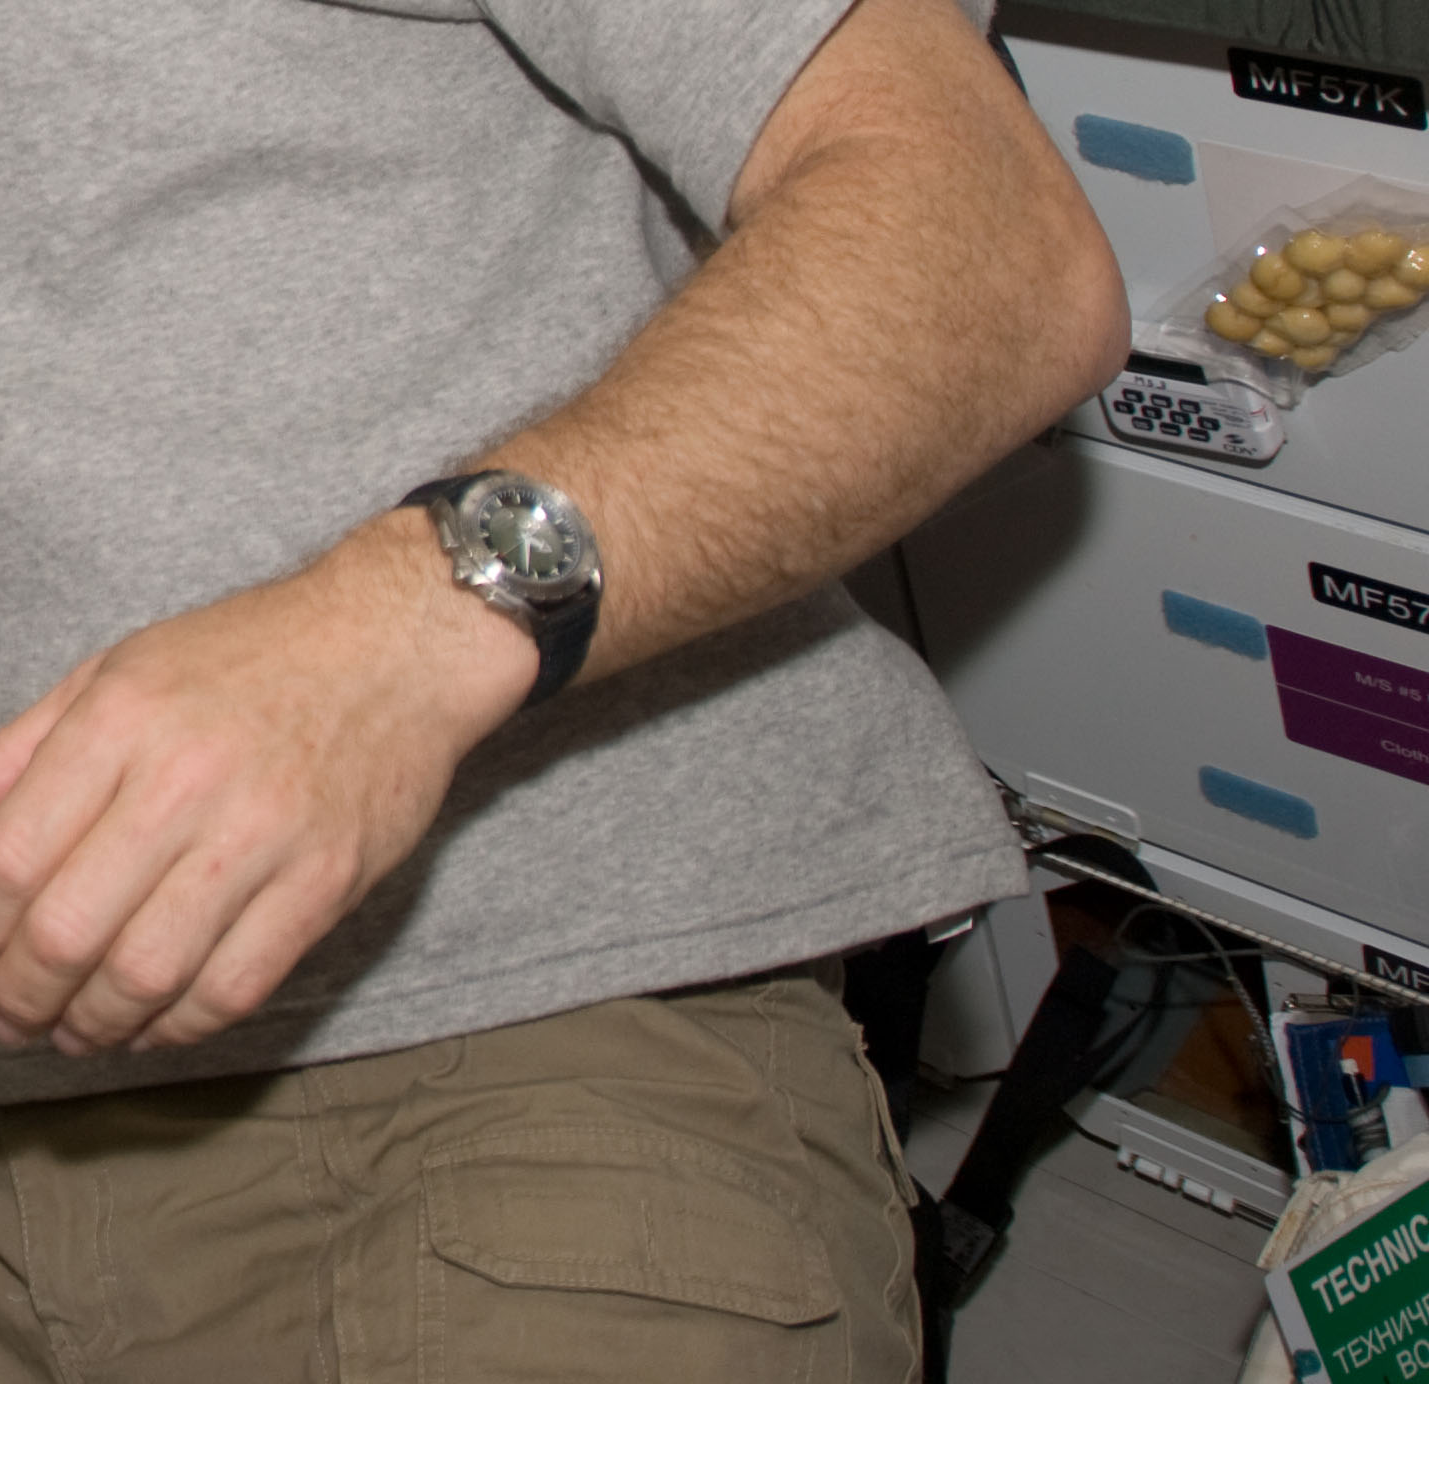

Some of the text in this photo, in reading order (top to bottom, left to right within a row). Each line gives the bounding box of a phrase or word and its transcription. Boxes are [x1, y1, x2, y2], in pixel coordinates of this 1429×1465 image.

[1248, 60, 1408, 117] MF57K
[1355, 671, 1422, 702] M/S #5
[1311, 1214, 1429, 1313] TECHNIC
